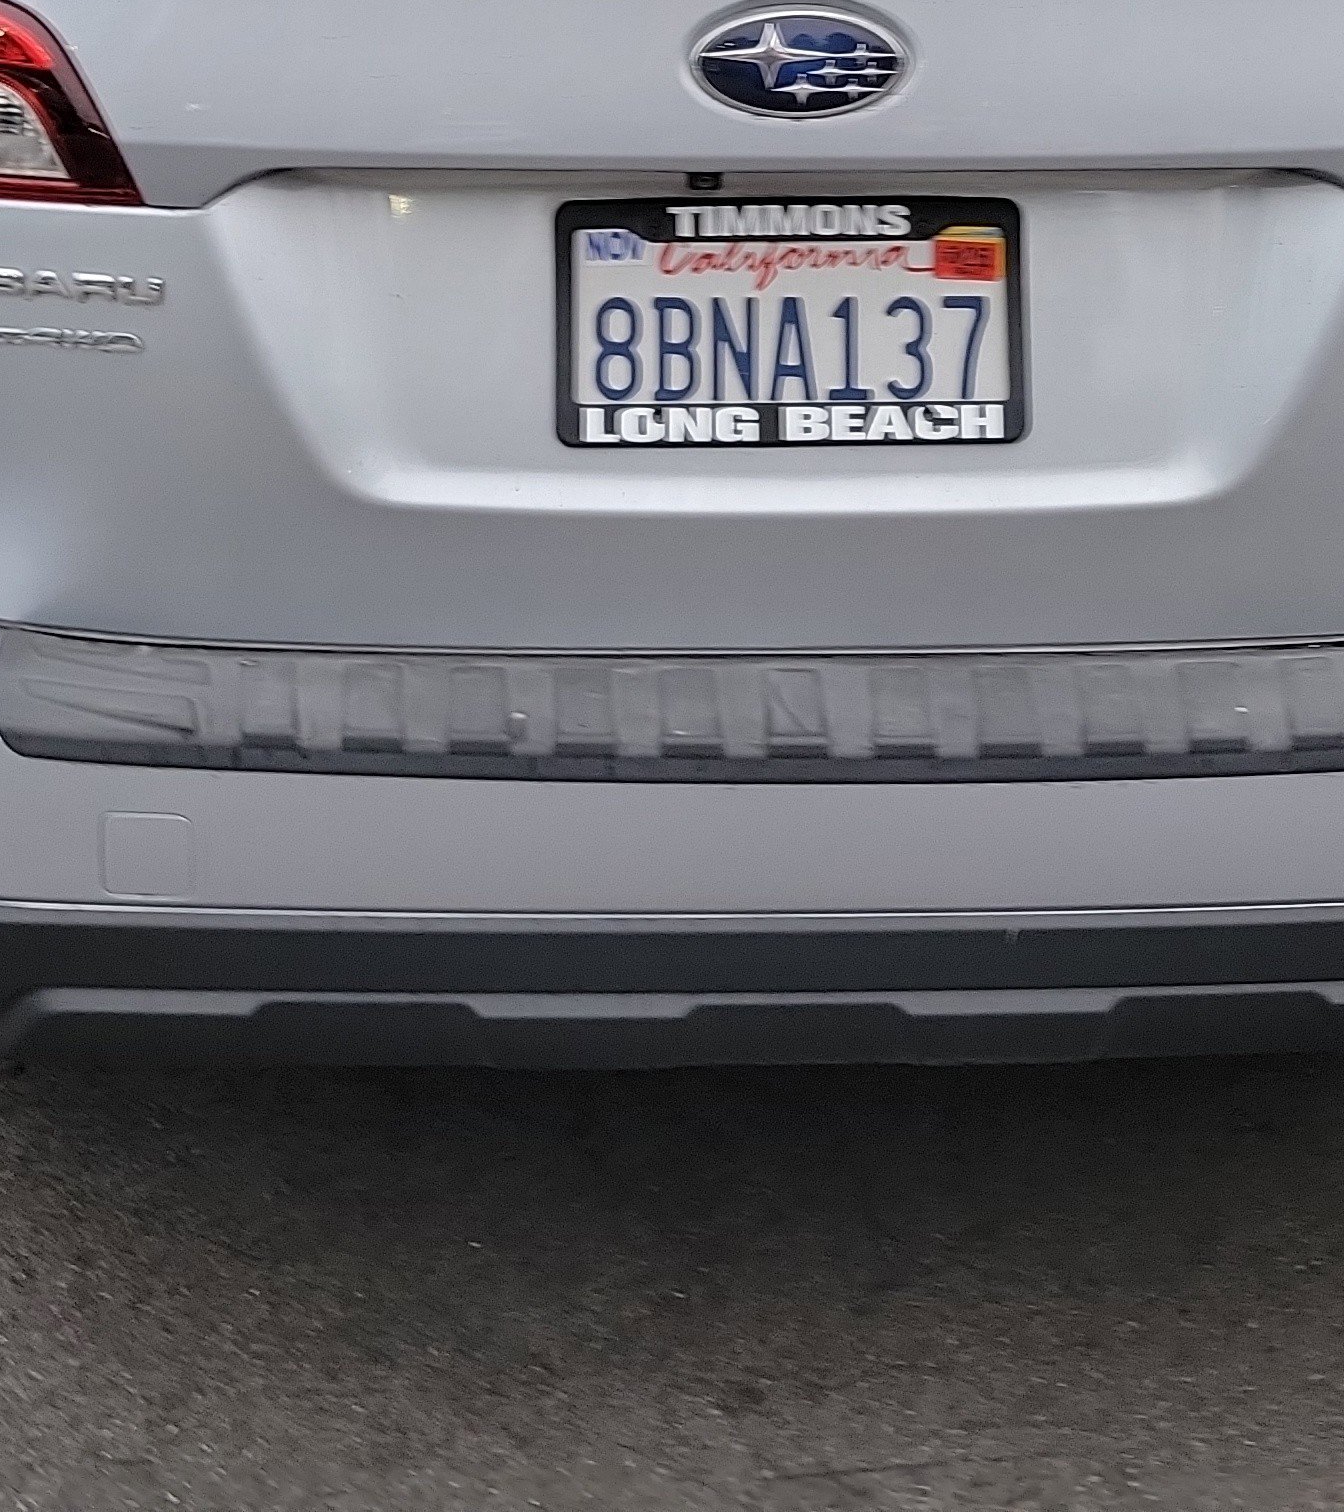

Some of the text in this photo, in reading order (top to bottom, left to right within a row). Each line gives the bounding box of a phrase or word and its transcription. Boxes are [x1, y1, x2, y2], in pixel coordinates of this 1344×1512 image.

[665, 204, 912, 237] TIMMONS
[659, 240, 912, 290] California
[594, 295, 992, 402] 8BNA137
[578, 404, 1006, 443] LONG BEACH
